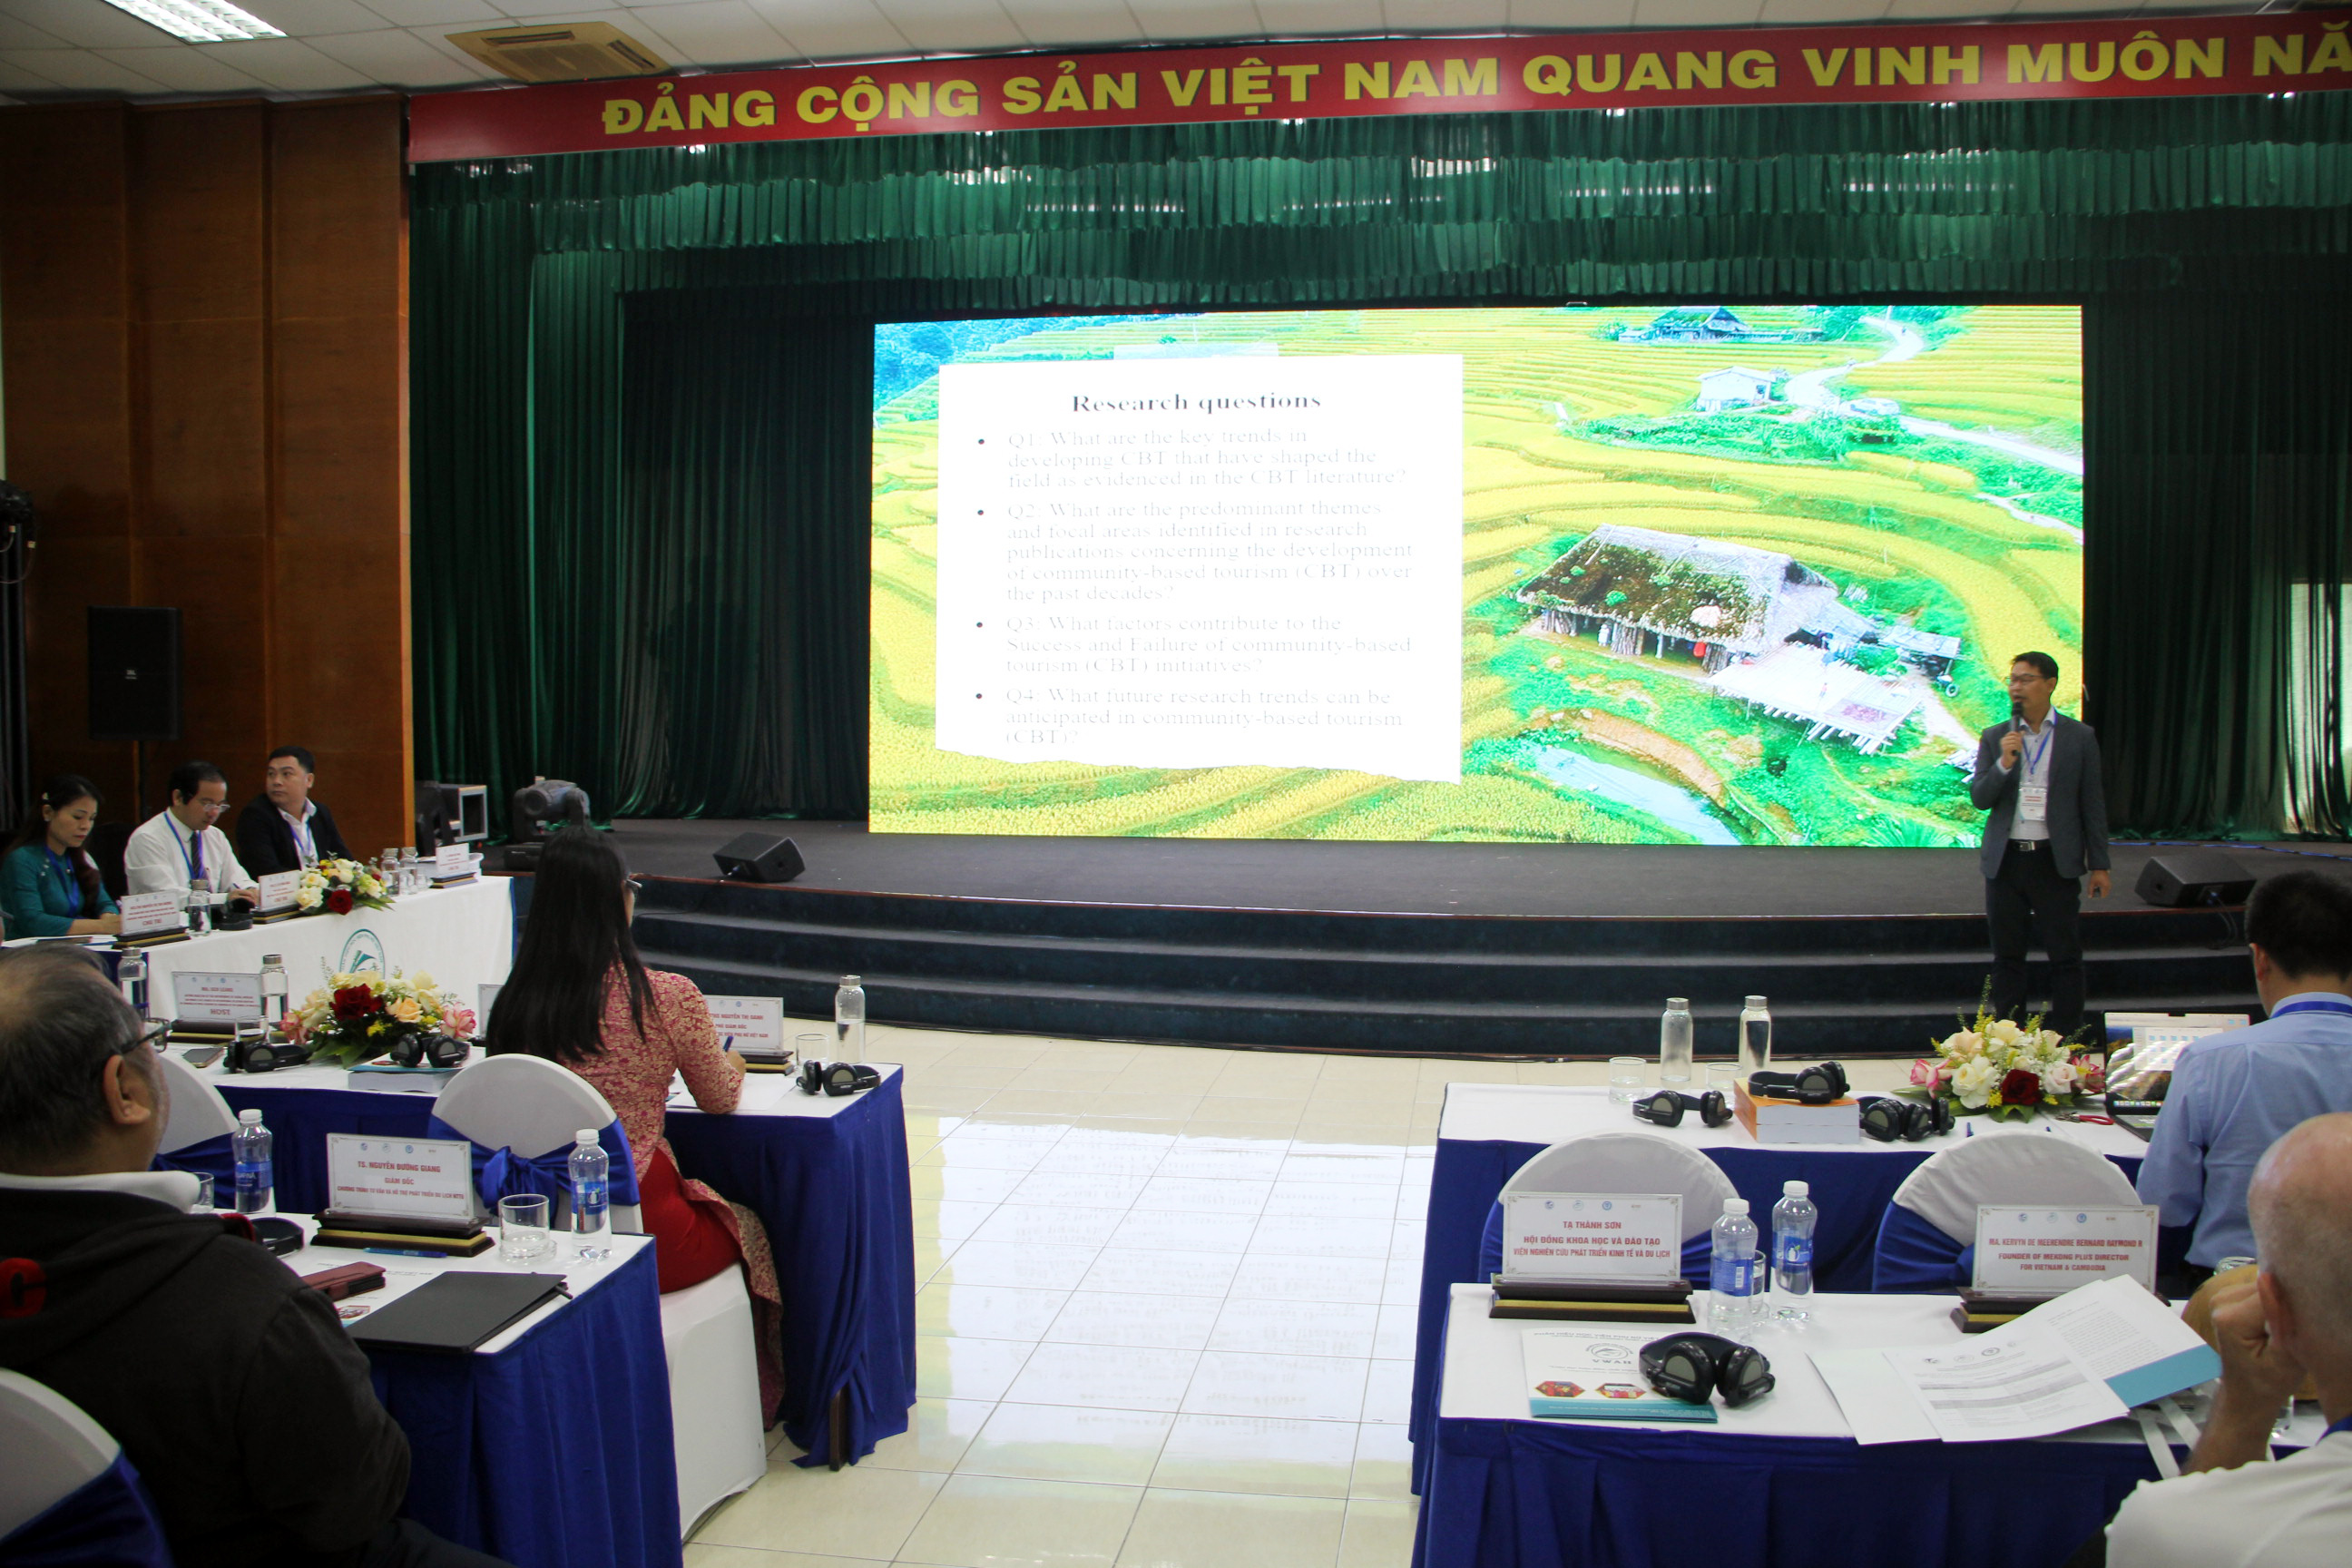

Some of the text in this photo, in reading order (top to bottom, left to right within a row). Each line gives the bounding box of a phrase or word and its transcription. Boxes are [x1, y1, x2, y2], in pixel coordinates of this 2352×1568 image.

[602, 82, 775, 134] ĐẢNG
[796, 75, 979, 132] CỘNG
[1002, 60, 1136, 114] SẢN
[1161, 57, 1320, 116] VIỆT
[1344, 57, 1498, 101] NAM
[1523, 49, 1776, 98] QUANG
[1802, 45, 1980, 87] VINH
[2007, 31, 2223, 83] MUÔN
[1073, 392, 1322, 415] Research questions
[1051, 429, 1101, 446] What
[1107, 434, 1137, 445] are
[1143, 428, 1172, 445] the
[1180, 428, 1214, 447] key
[1221, 427, 1281, 444] trends
[1289, 426, 1307, 443] in
[1008, 447, 1377, 469] developing CBT that have shaped the
[1008, 468, 1406, 486] field as evidenced in the CBT literature?
[1050, 501, 1100, 517] What
[1107, 505, 1137, 516] are
[1143, 501, 1172, 516] the
[1180, 500, 1304, 519] predominant
[1310, 500, 1381, 515] themes
[1007, 521, 1368, 537] and focal areas identified in research
[1007, 541, 1413, 561] publications concerning the development
[1007, 564, 1412, 583] of community-based tourism (CBT) over
[1007, 585, 1174, 604] the past decades?
[1049, 615, 1100, 631] What
[1107, 615, 1172, 631] factors
[1180, 615, 1279, 631] contribute
[1285, 615, 1305, 631] to
[1311, 615, 1341, 631] the
[1005, 636, 1412, 655] Success and Failure of community-based
[1005, 656, 1262, 674] tourism (CBT) initiatives?
[1048, 688, 1100, 703] What
[1107, 688, 1163, 703] future
[1171, 688, 1251, 703] research
[1258, 688, 1319, 703] trends
[1326, 692, 1361, 703] can
[1367, 688, 1392, 703] be
[1005, 709, 1403, 728] anticipated in community-based tourism
[1005, 728, 1079, 746] (CBT)?
[1604, 1221, 1622, 1230] SƠN
[1524, 1235, 1538, 1245] HỘI
[1541, 1234, 1563, 1244] ĐỒNG
[1592, 1237, 1609, 1246] HỌC
[1612, 1236, 1622, 1245] VÀ
[1624, 1236, 1642, 1245] ĐÀO
[1644, 1238, 1661, 1247] TẠO
